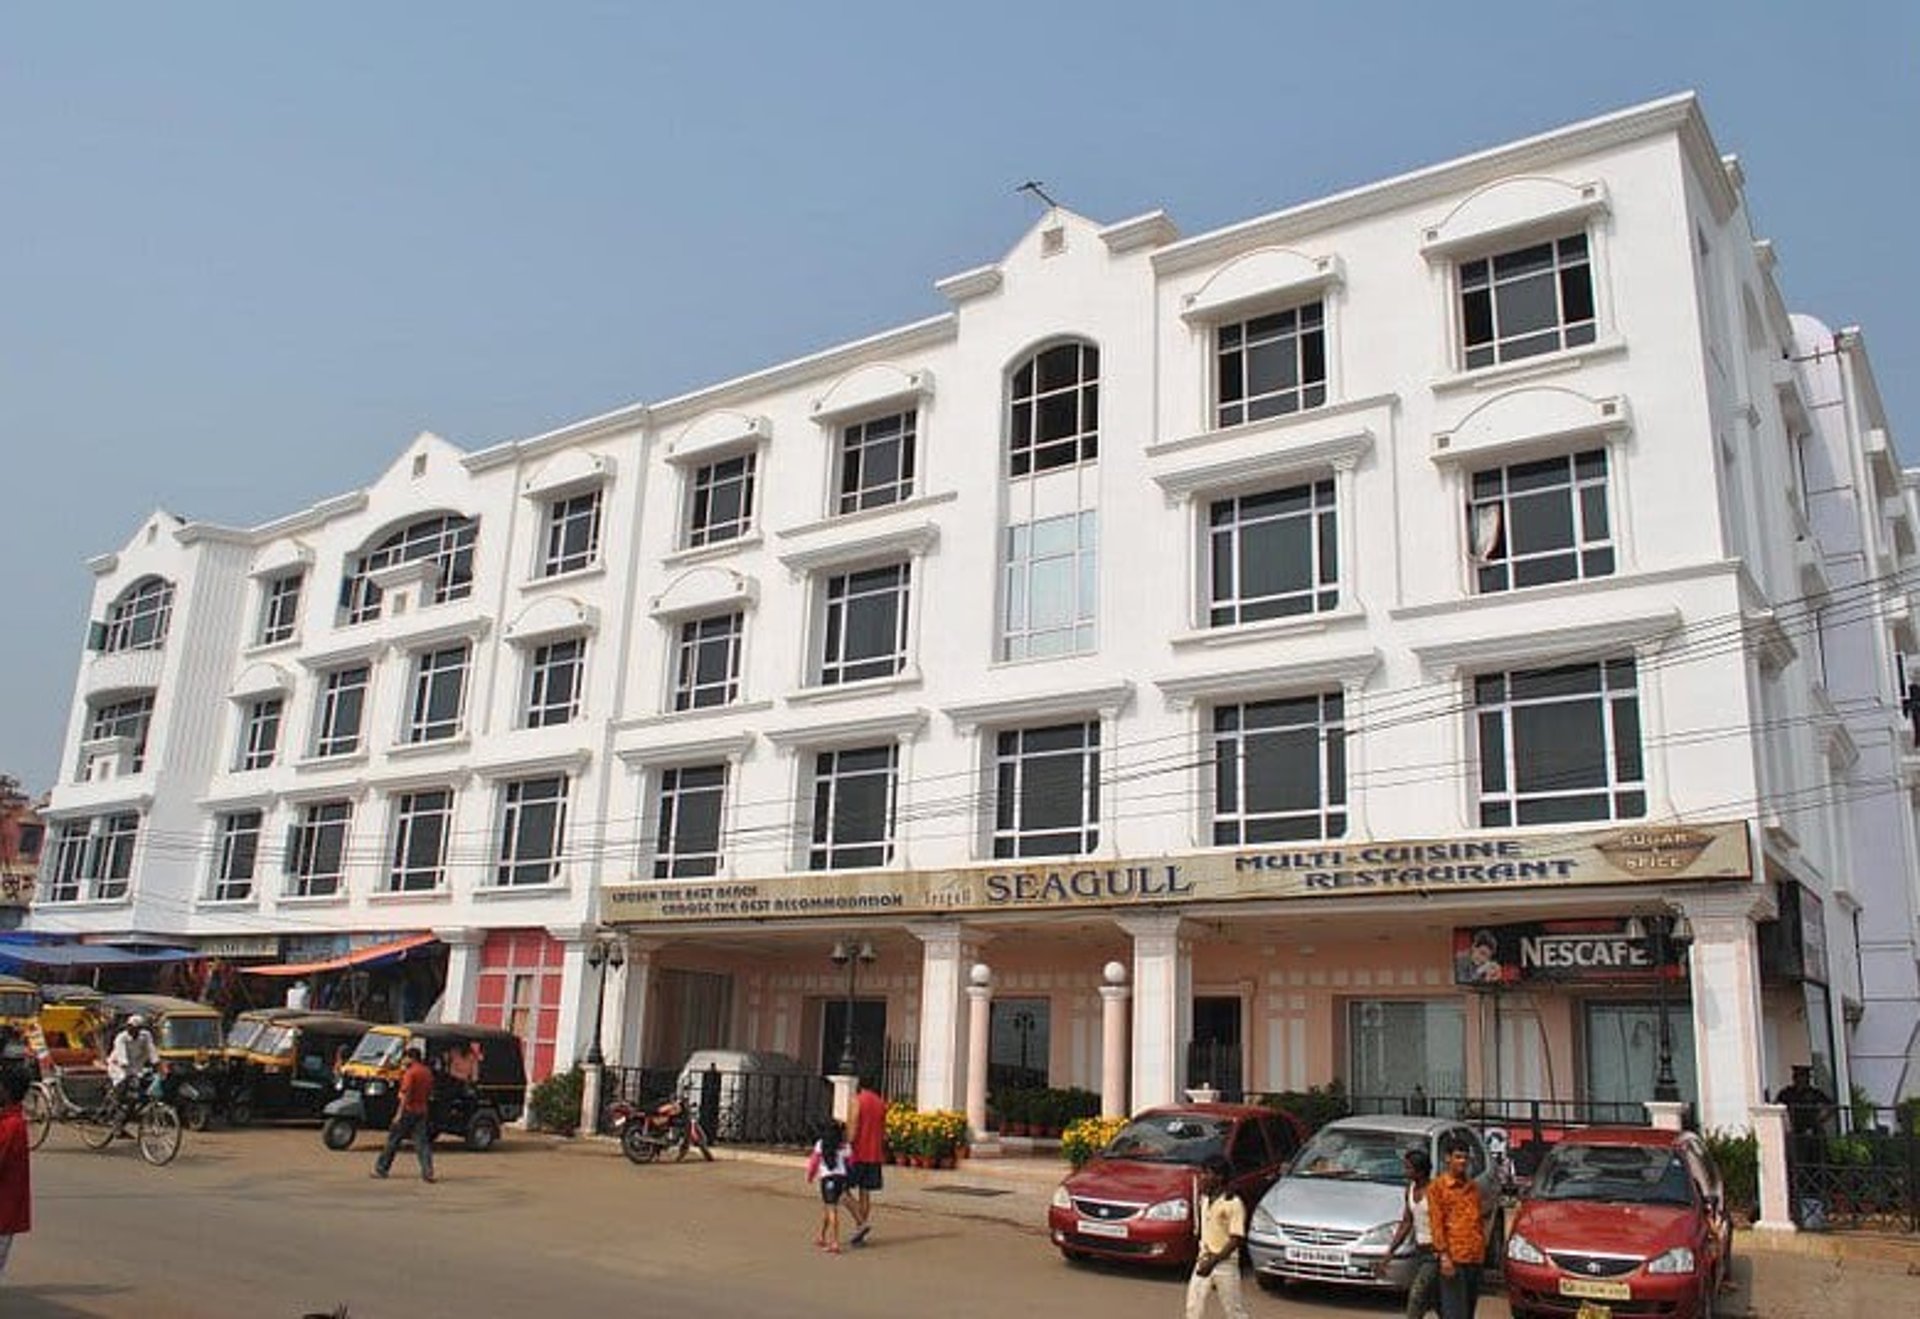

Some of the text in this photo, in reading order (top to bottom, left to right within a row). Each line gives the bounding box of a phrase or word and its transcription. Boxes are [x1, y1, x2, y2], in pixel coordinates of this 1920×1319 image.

[1304, 858, 1577, 889] RESTAURANT
[1626, 857, 1682, 869] SPICE
[986, 865, 1194, 904] SEAGULL
[714, 902, 736, 913] THE
[740, 900, 770, 912] BEST
